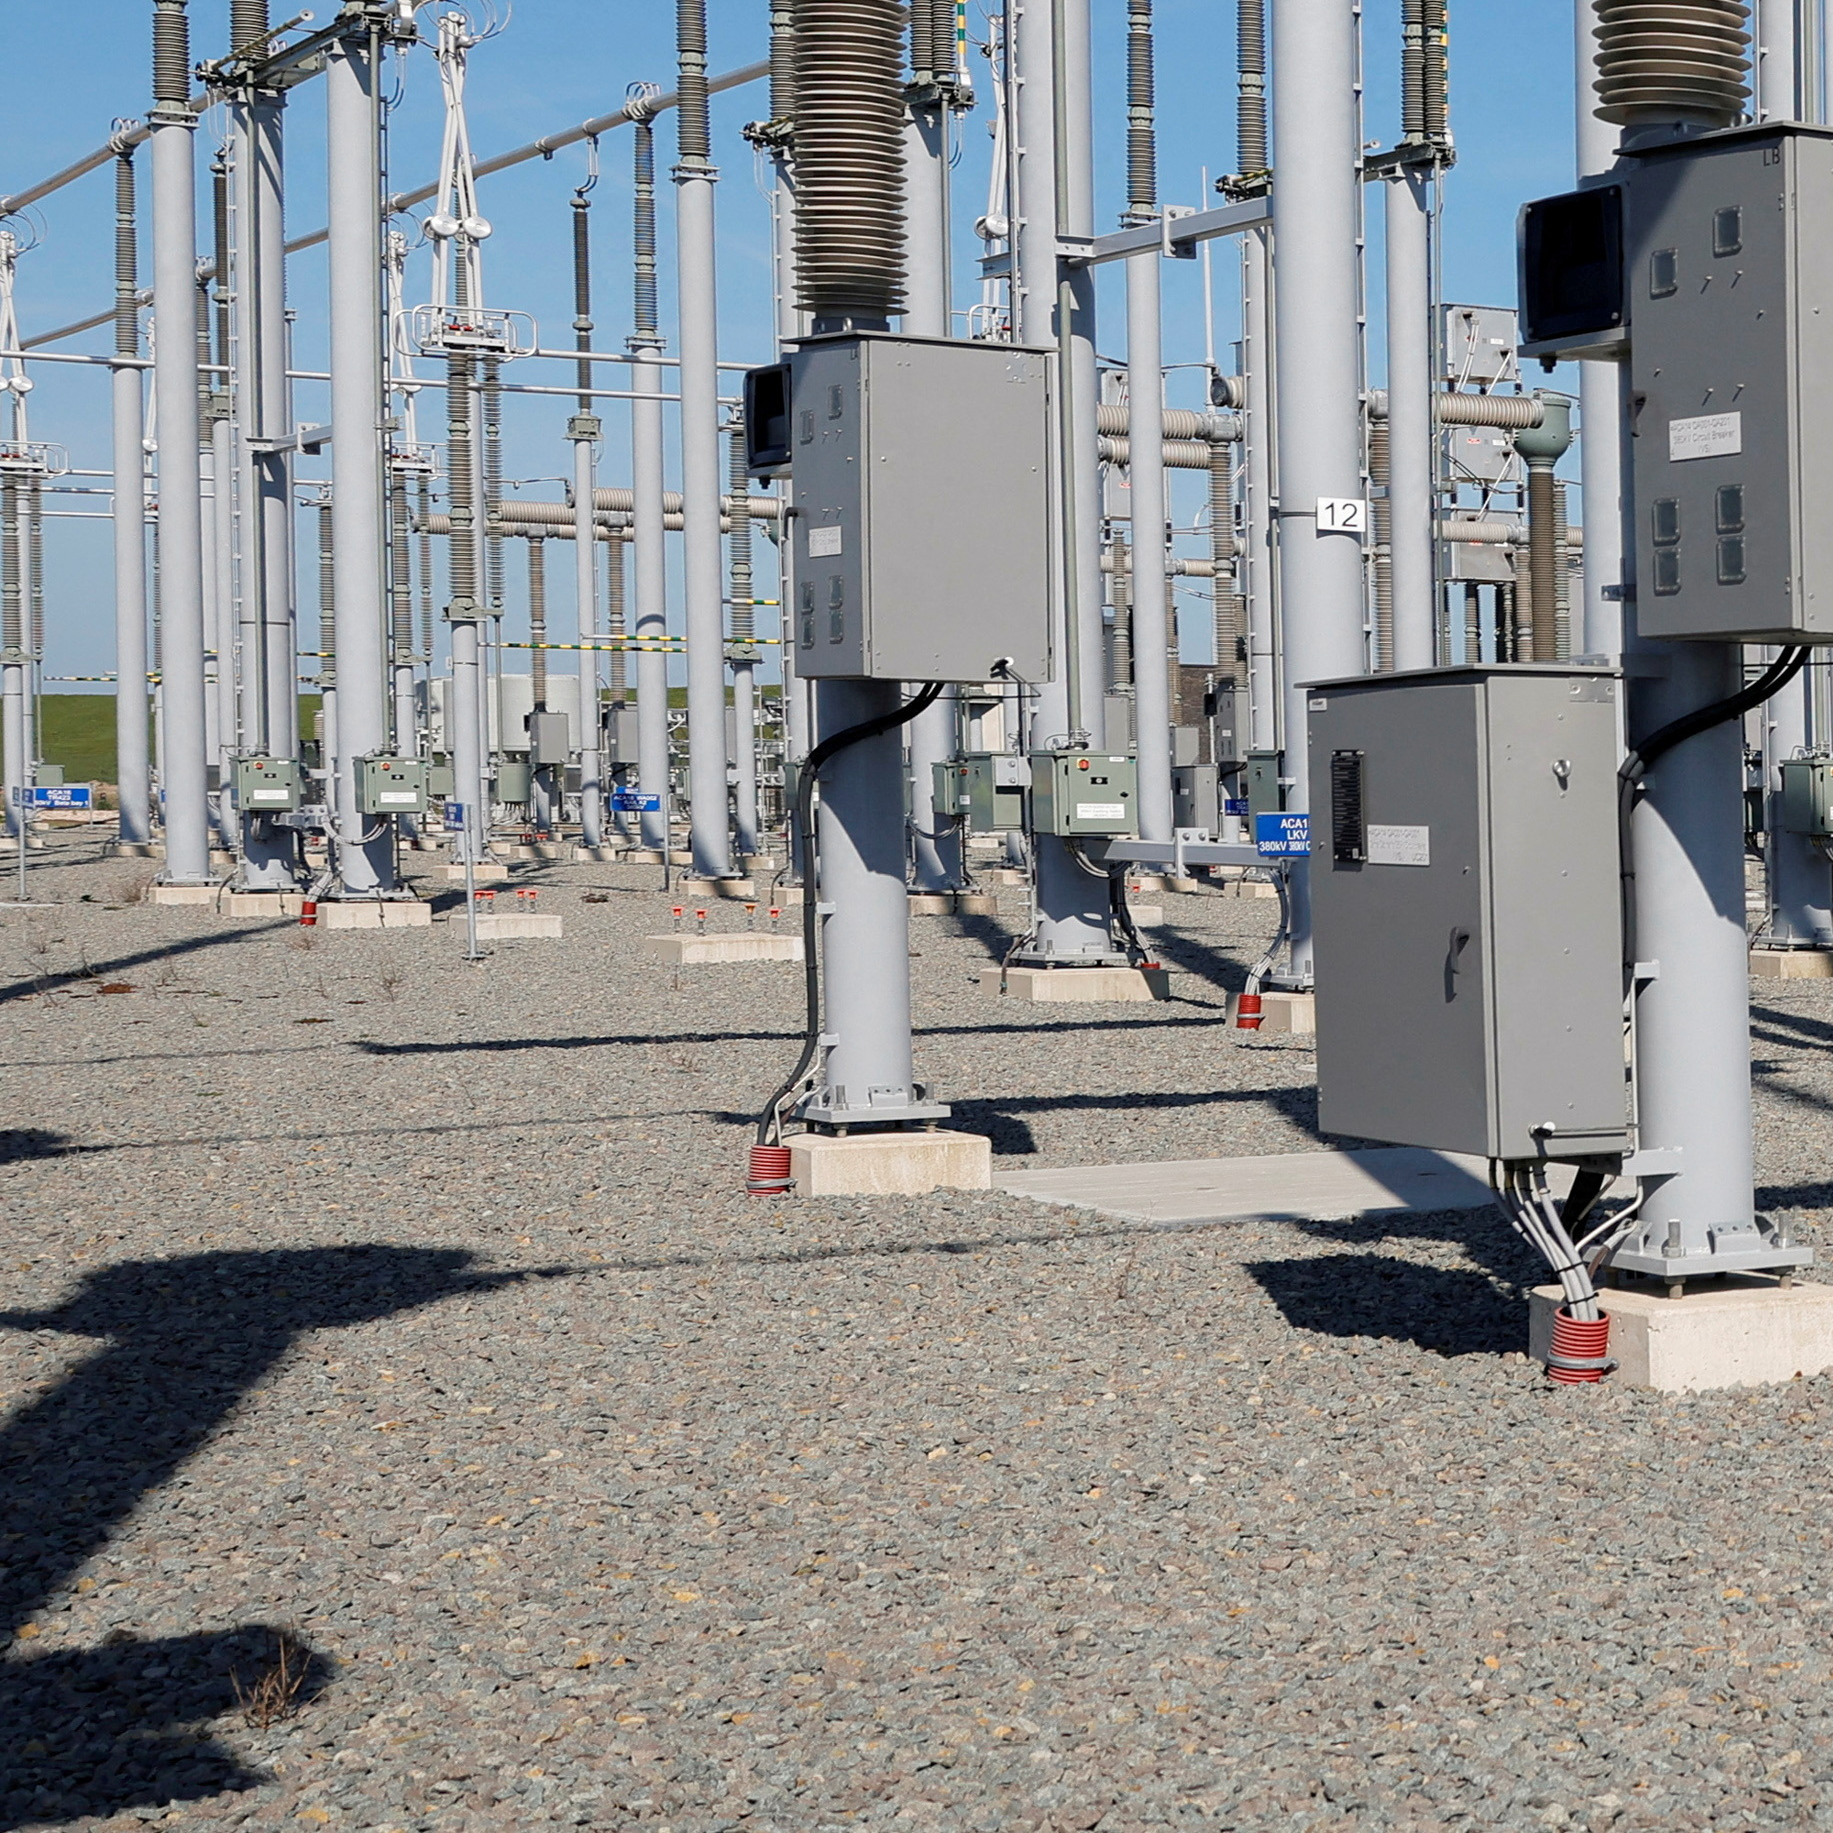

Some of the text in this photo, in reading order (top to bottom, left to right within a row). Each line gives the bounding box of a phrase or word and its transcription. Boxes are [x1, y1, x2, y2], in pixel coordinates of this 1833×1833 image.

[1764, 146, 1780, 166] LB
[1325, 502, 1358, 527] 12
[1287, 830, 1308, 840] LKV
[1260, 841, 1287, 852] 380kV
